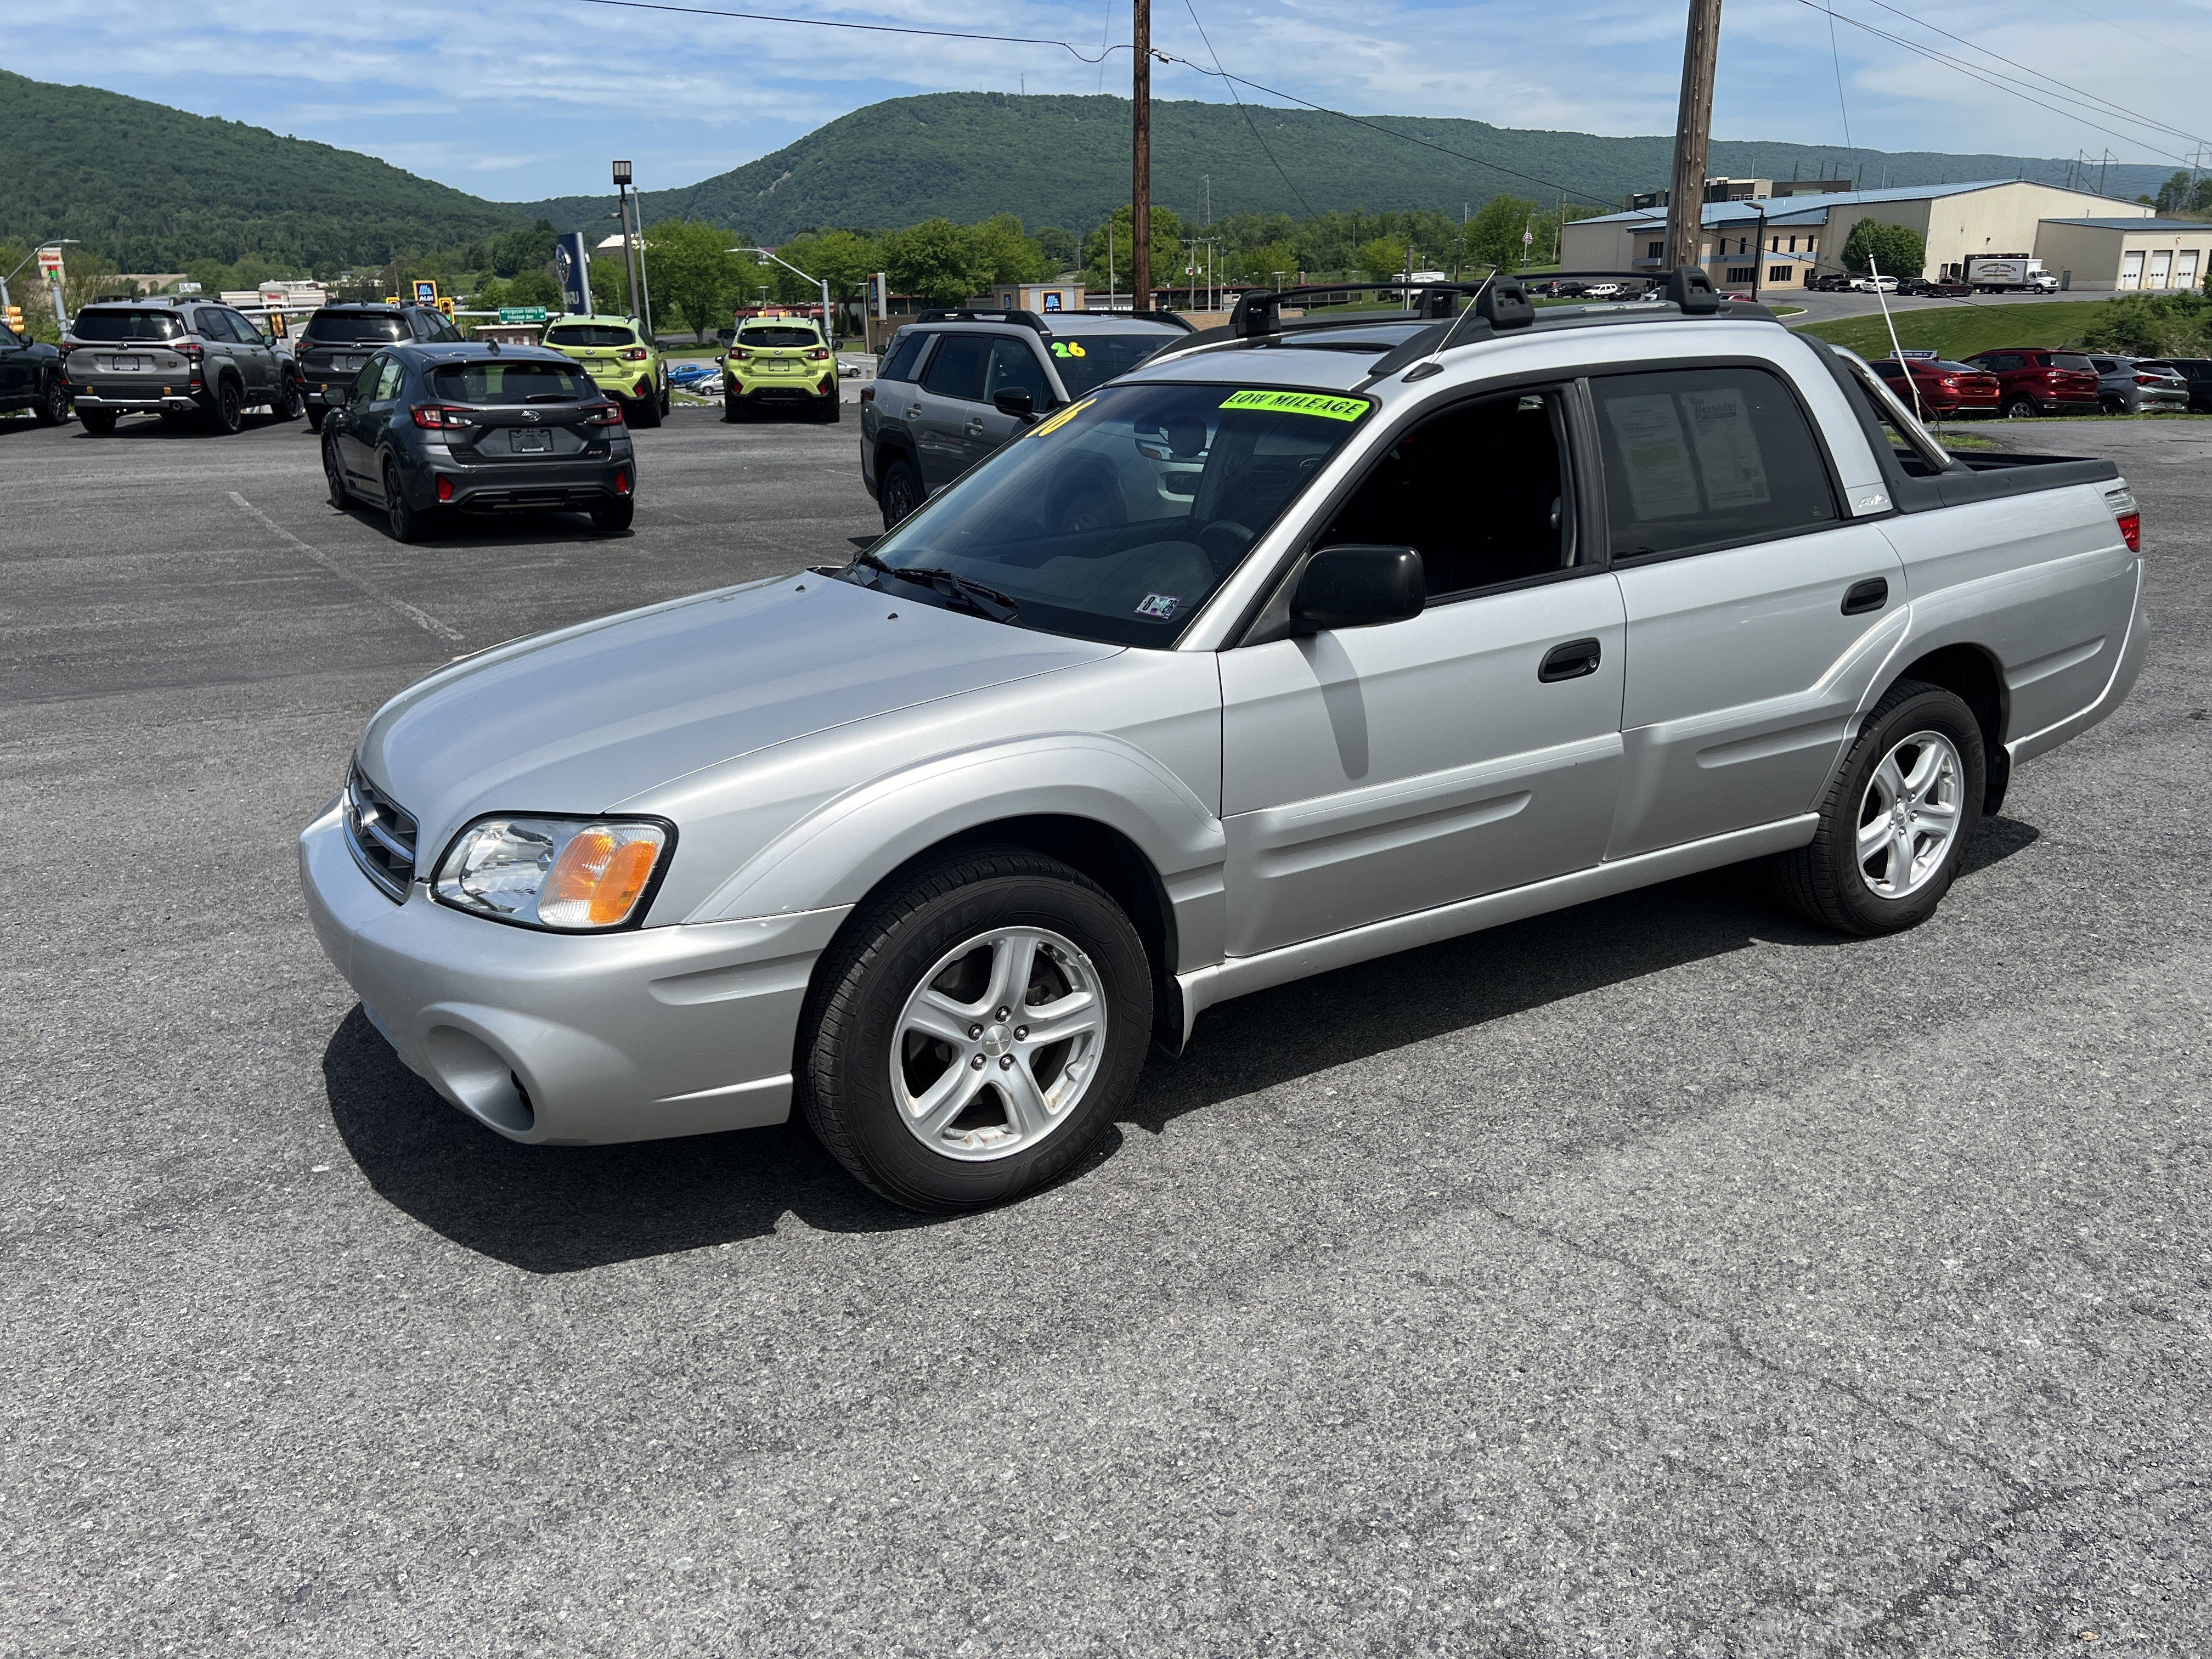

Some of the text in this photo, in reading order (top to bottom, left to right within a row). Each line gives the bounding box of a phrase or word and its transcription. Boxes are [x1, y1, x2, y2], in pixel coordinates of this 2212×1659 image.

[1051, 342, 1086, 357] 26
[1226, 393, 1365, 415] LOW MILEAGE
[1695, 402, 1737, 420] Alexander
[858, 903, 980, 1069] GOODYEAR
[1037, 1030, 1139, 1181] ASSURANCE
